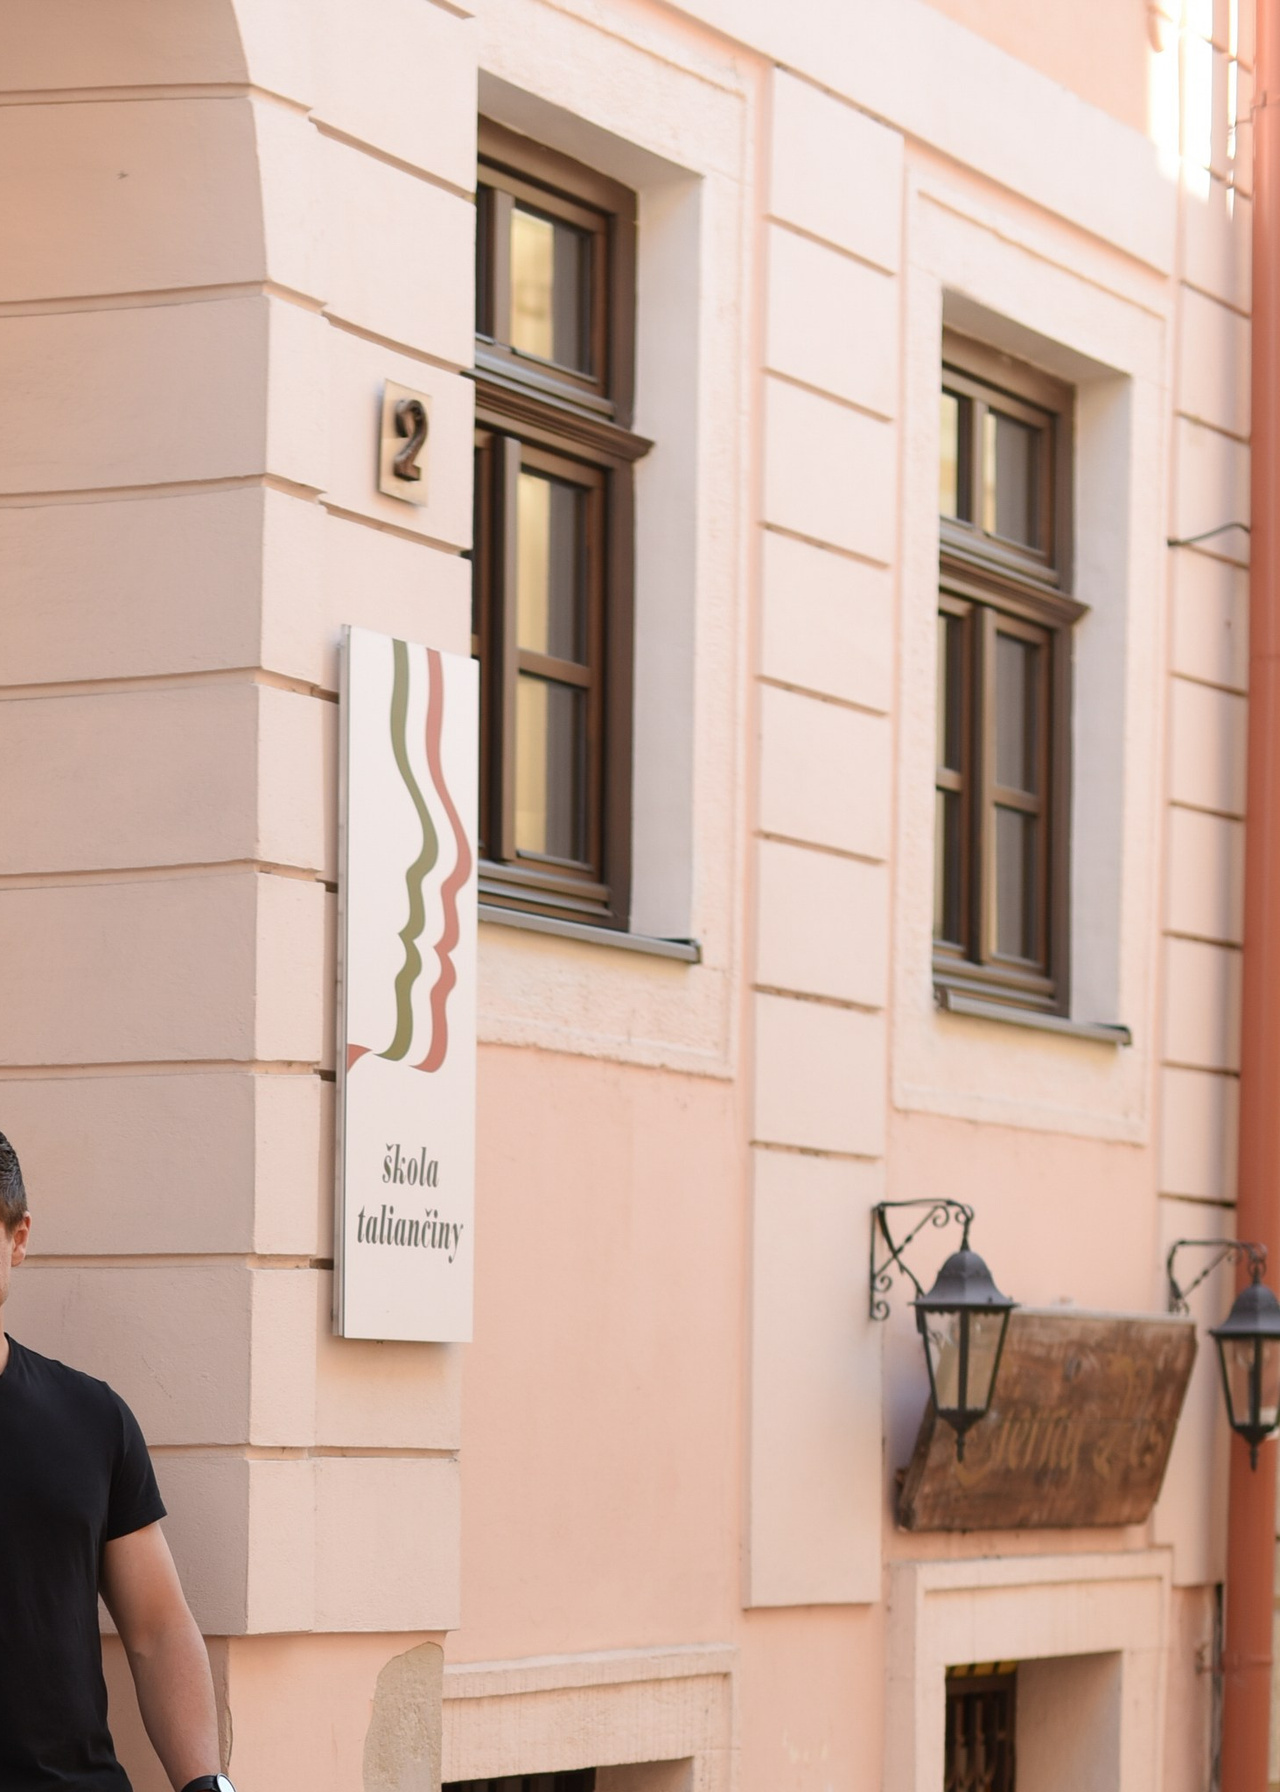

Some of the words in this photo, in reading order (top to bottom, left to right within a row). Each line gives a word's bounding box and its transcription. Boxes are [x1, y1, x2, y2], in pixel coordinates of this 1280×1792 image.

[393, 399, 428, 482] 2
[382, 1142, 440, 1188] škola
[357, 1203, 464, 1264] taliančiny
